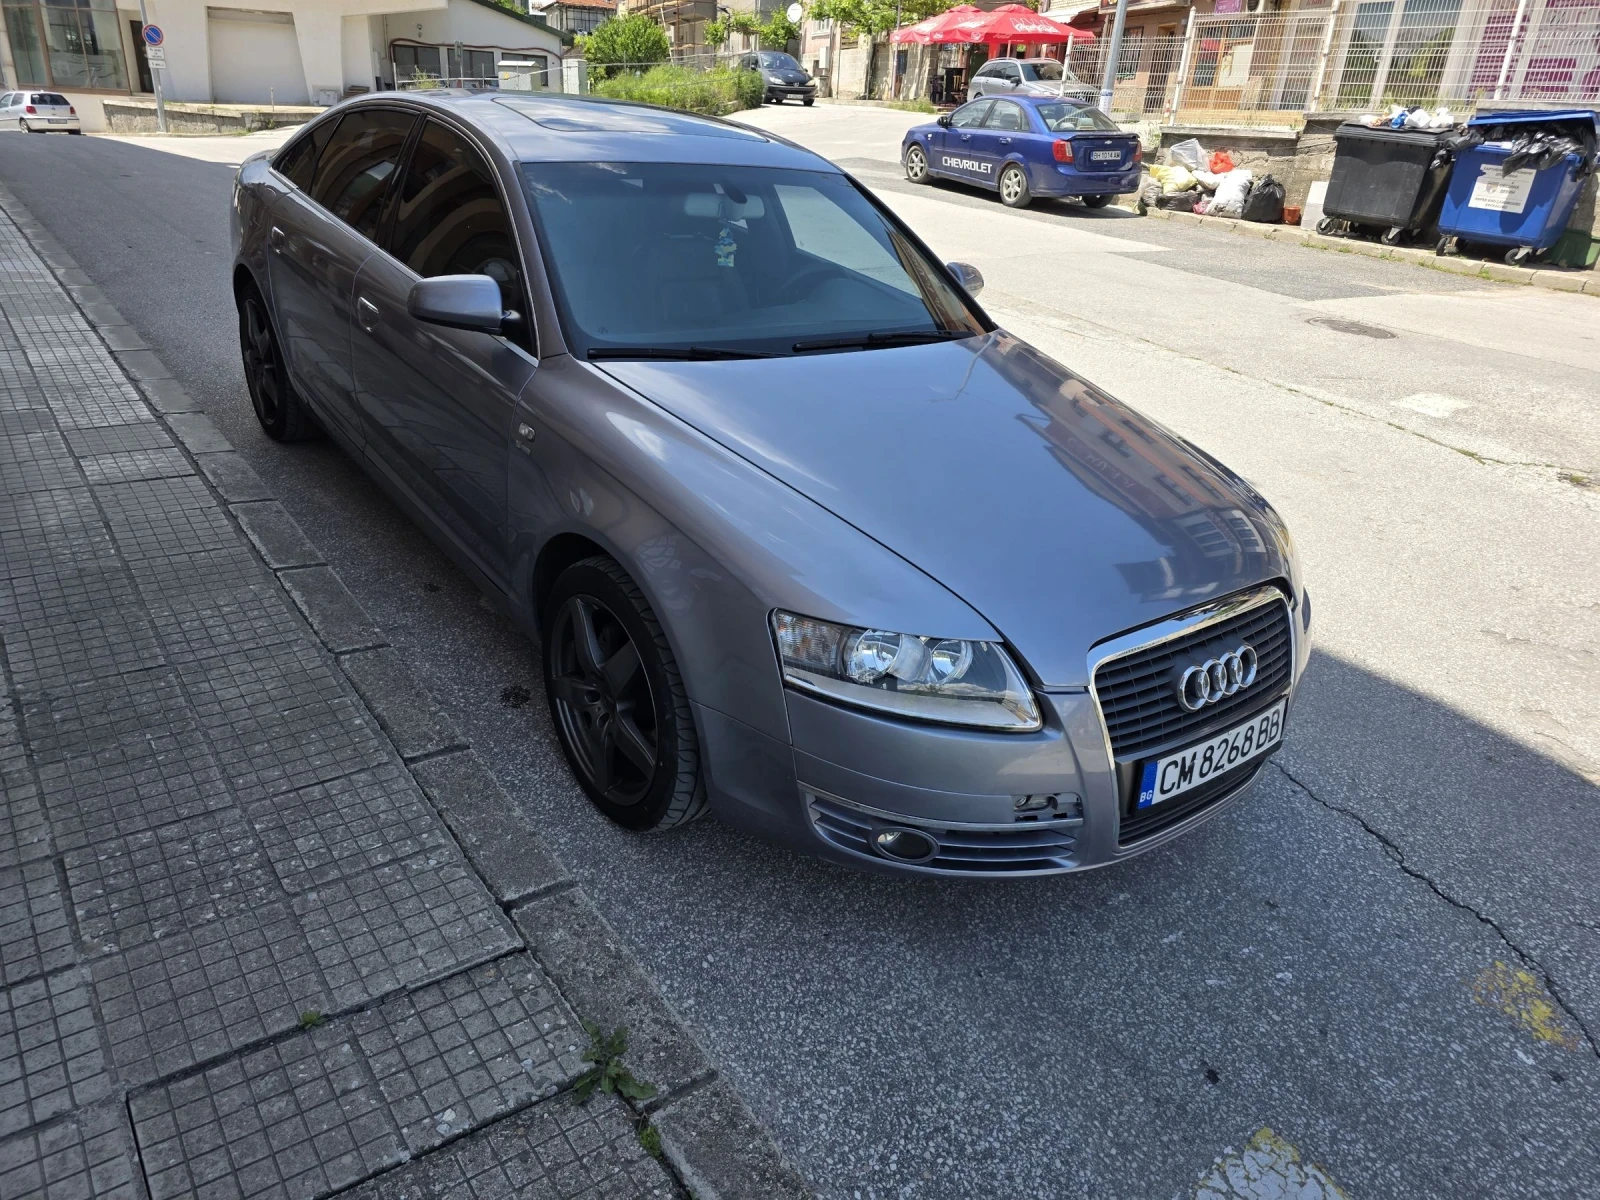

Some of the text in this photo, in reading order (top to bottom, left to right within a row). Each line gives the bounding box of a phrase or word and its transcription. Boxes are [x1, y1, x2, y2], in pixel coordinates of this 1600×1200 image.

[942, 156, 993, 174] CHEVROLET
[1199, 725, 1255, 779] 8268
[1255, 708, 1281, 751] BB
[1139, 789, 1153, 803] BG
